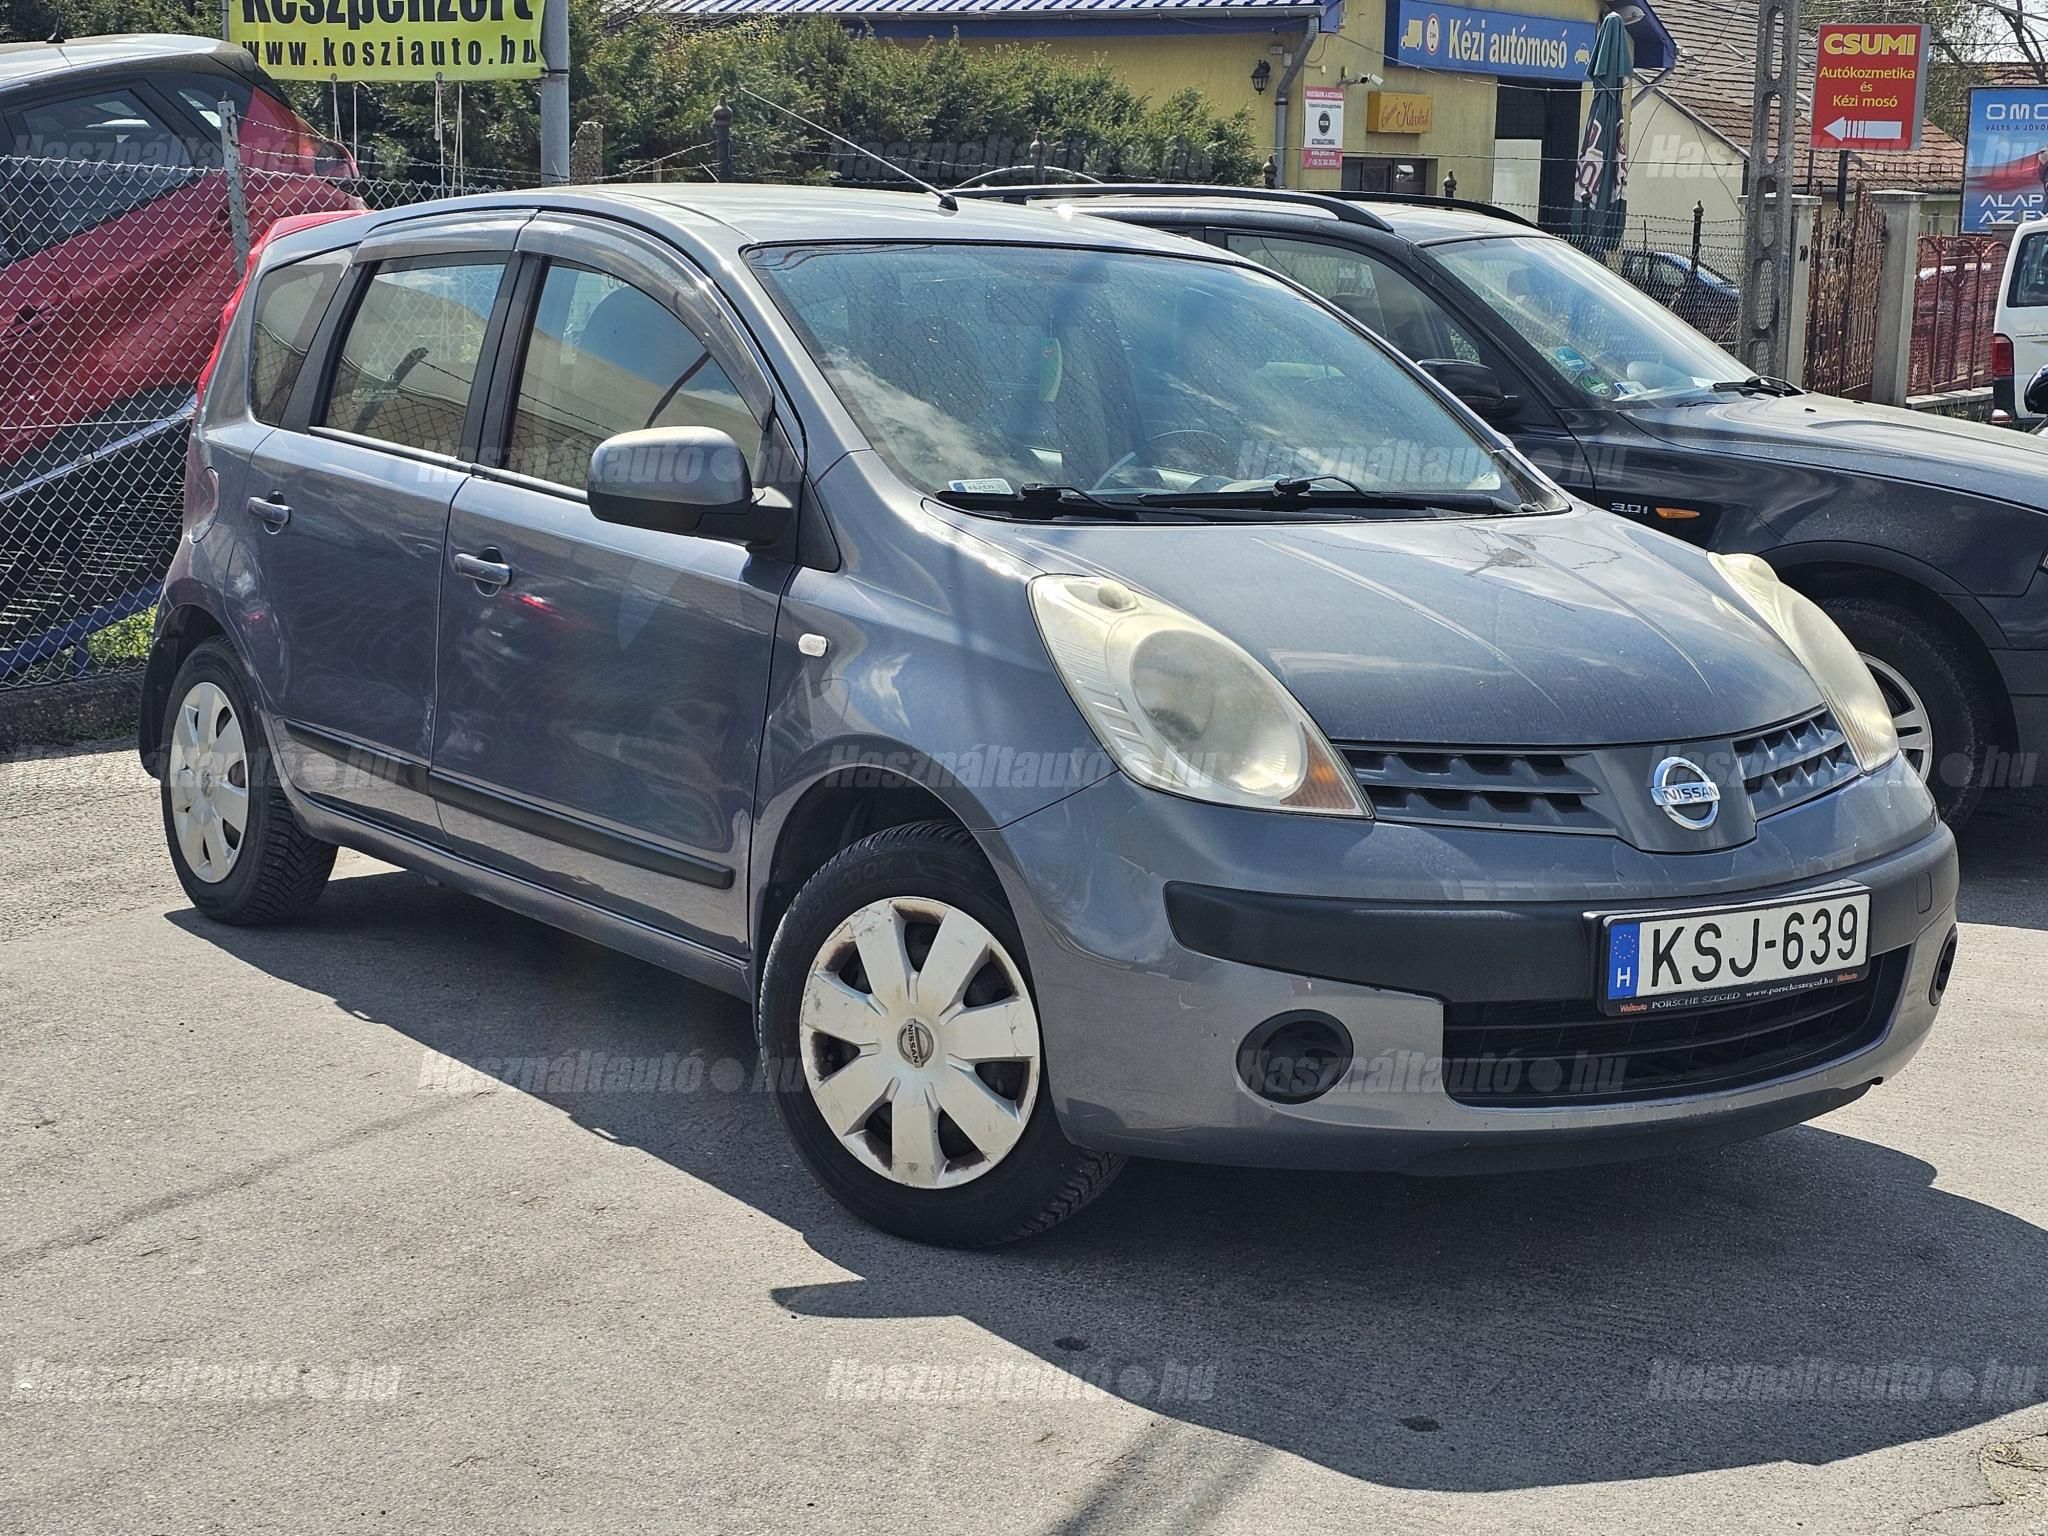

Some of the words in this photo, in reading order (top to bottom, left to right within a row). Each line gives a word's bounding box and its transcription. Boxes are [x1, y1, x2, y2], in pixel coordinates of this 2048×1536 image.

[241, 35, 537, 67] www.kosziauto.hu
[1449, 17, 1486, 62] Kézi
[1489, 24, 1568, 70] autómosó
[1823, 33, 1916, 56] CSUMI
[1819, 66, 1915, 79] Autókozmetika
[1860, 81, 1873, 92] és
[1833, 95, 1858, 107] Kézi
[1862, 95, 1898, 108] mosó
[1979, 210, 2015, 224] AZ
[1663, 786, 1718, 801] NISSAN
[1651, 904, 1858, 988] KSJ-639
[1616, 967, 1631, 988] H
[1652, 997, 1700, 1009] PORSCHE
[1701, 991, 1741, 1003] SZEGED
[907, 1023, 920, 1064] NISSAN
